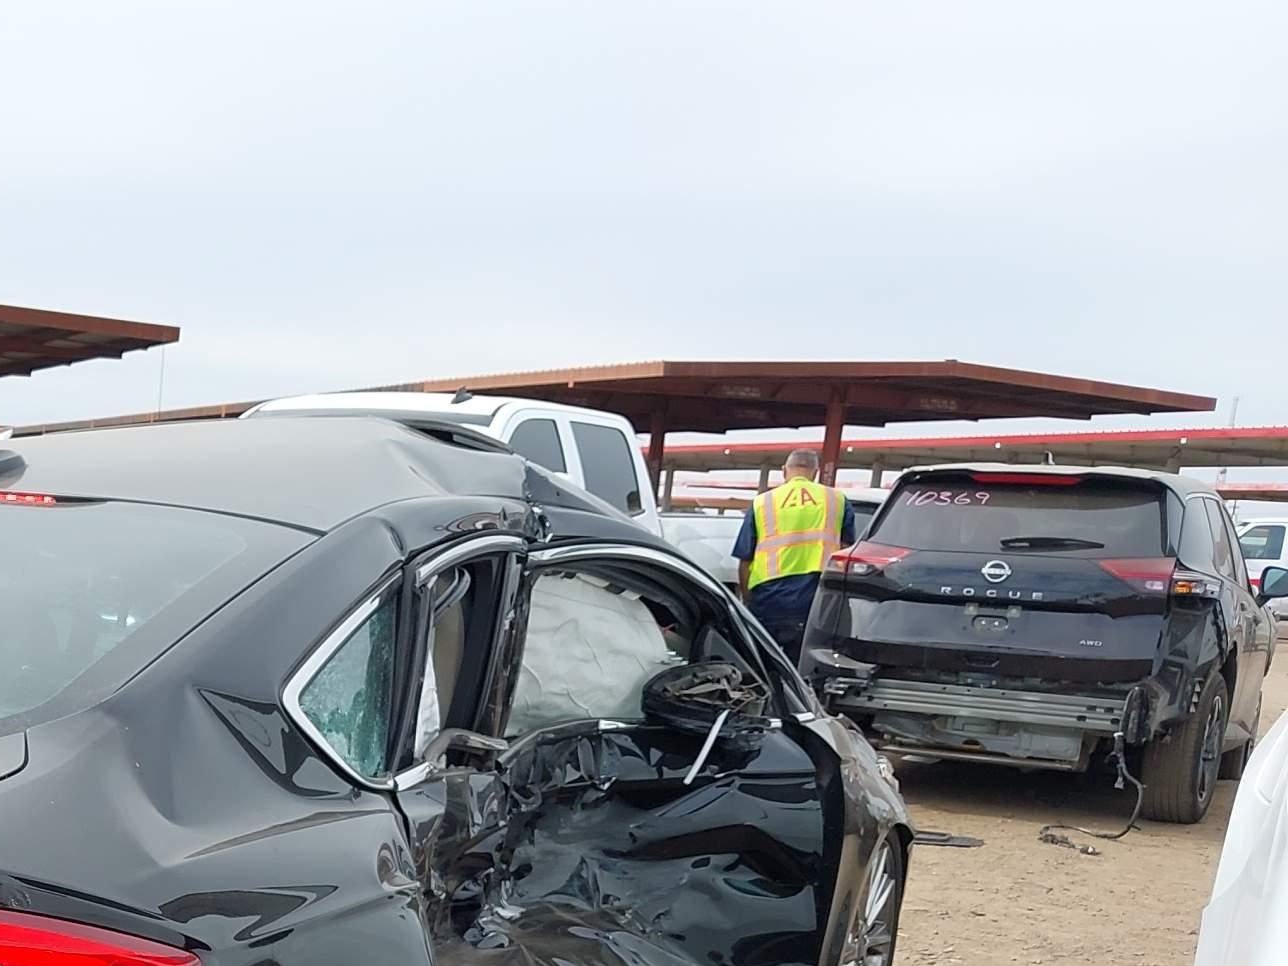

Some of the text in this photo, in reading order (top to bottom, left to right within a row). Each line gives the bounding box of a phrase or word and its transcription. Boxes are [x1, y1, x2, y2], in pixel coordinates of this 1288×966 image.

[906, 490, 991, 506] 10369
[940, 585, 1044, 601] ROGUE
[1078, 639, 1103, 648] AWD
